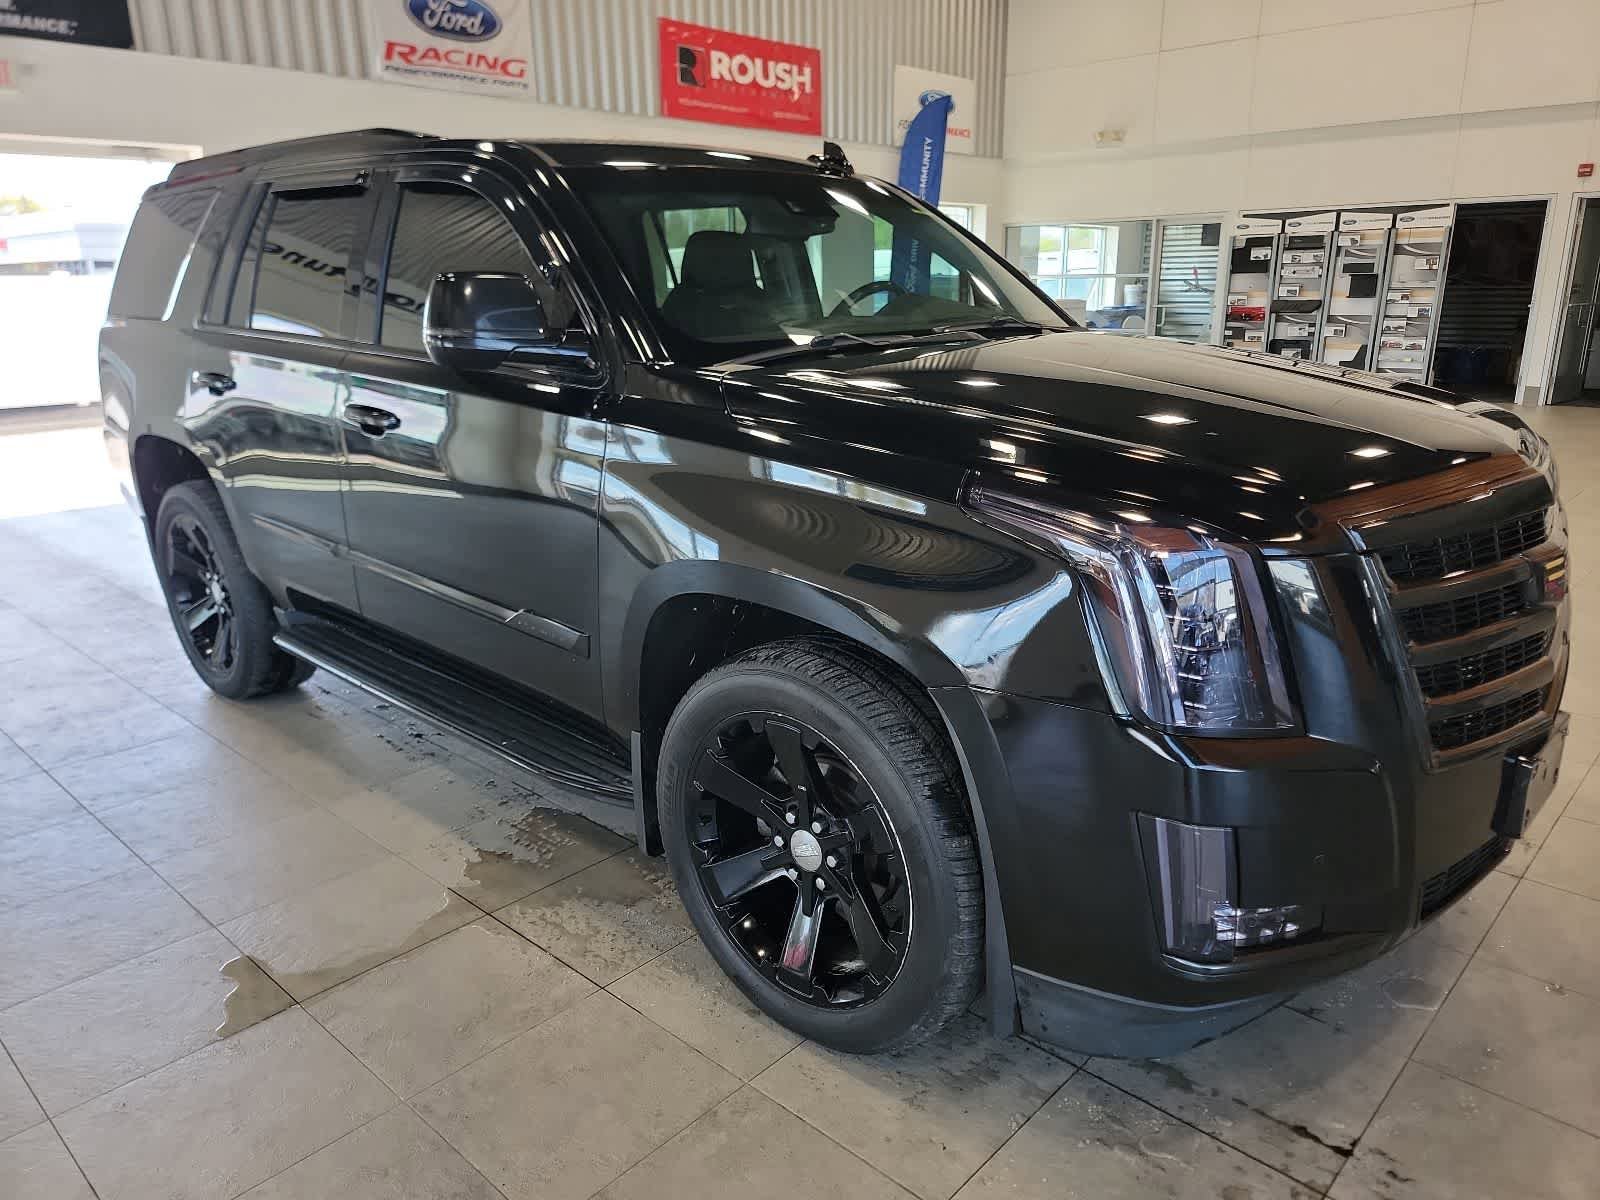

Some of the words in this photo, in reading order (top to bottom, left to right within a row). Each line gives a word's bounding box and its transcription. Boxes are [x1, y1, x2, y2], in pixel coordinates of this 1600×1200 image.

[423, 0, 486, 35] Ford
[383, 41, 528, 79] RACING
[710, 49, 813, 103] ROUSH
